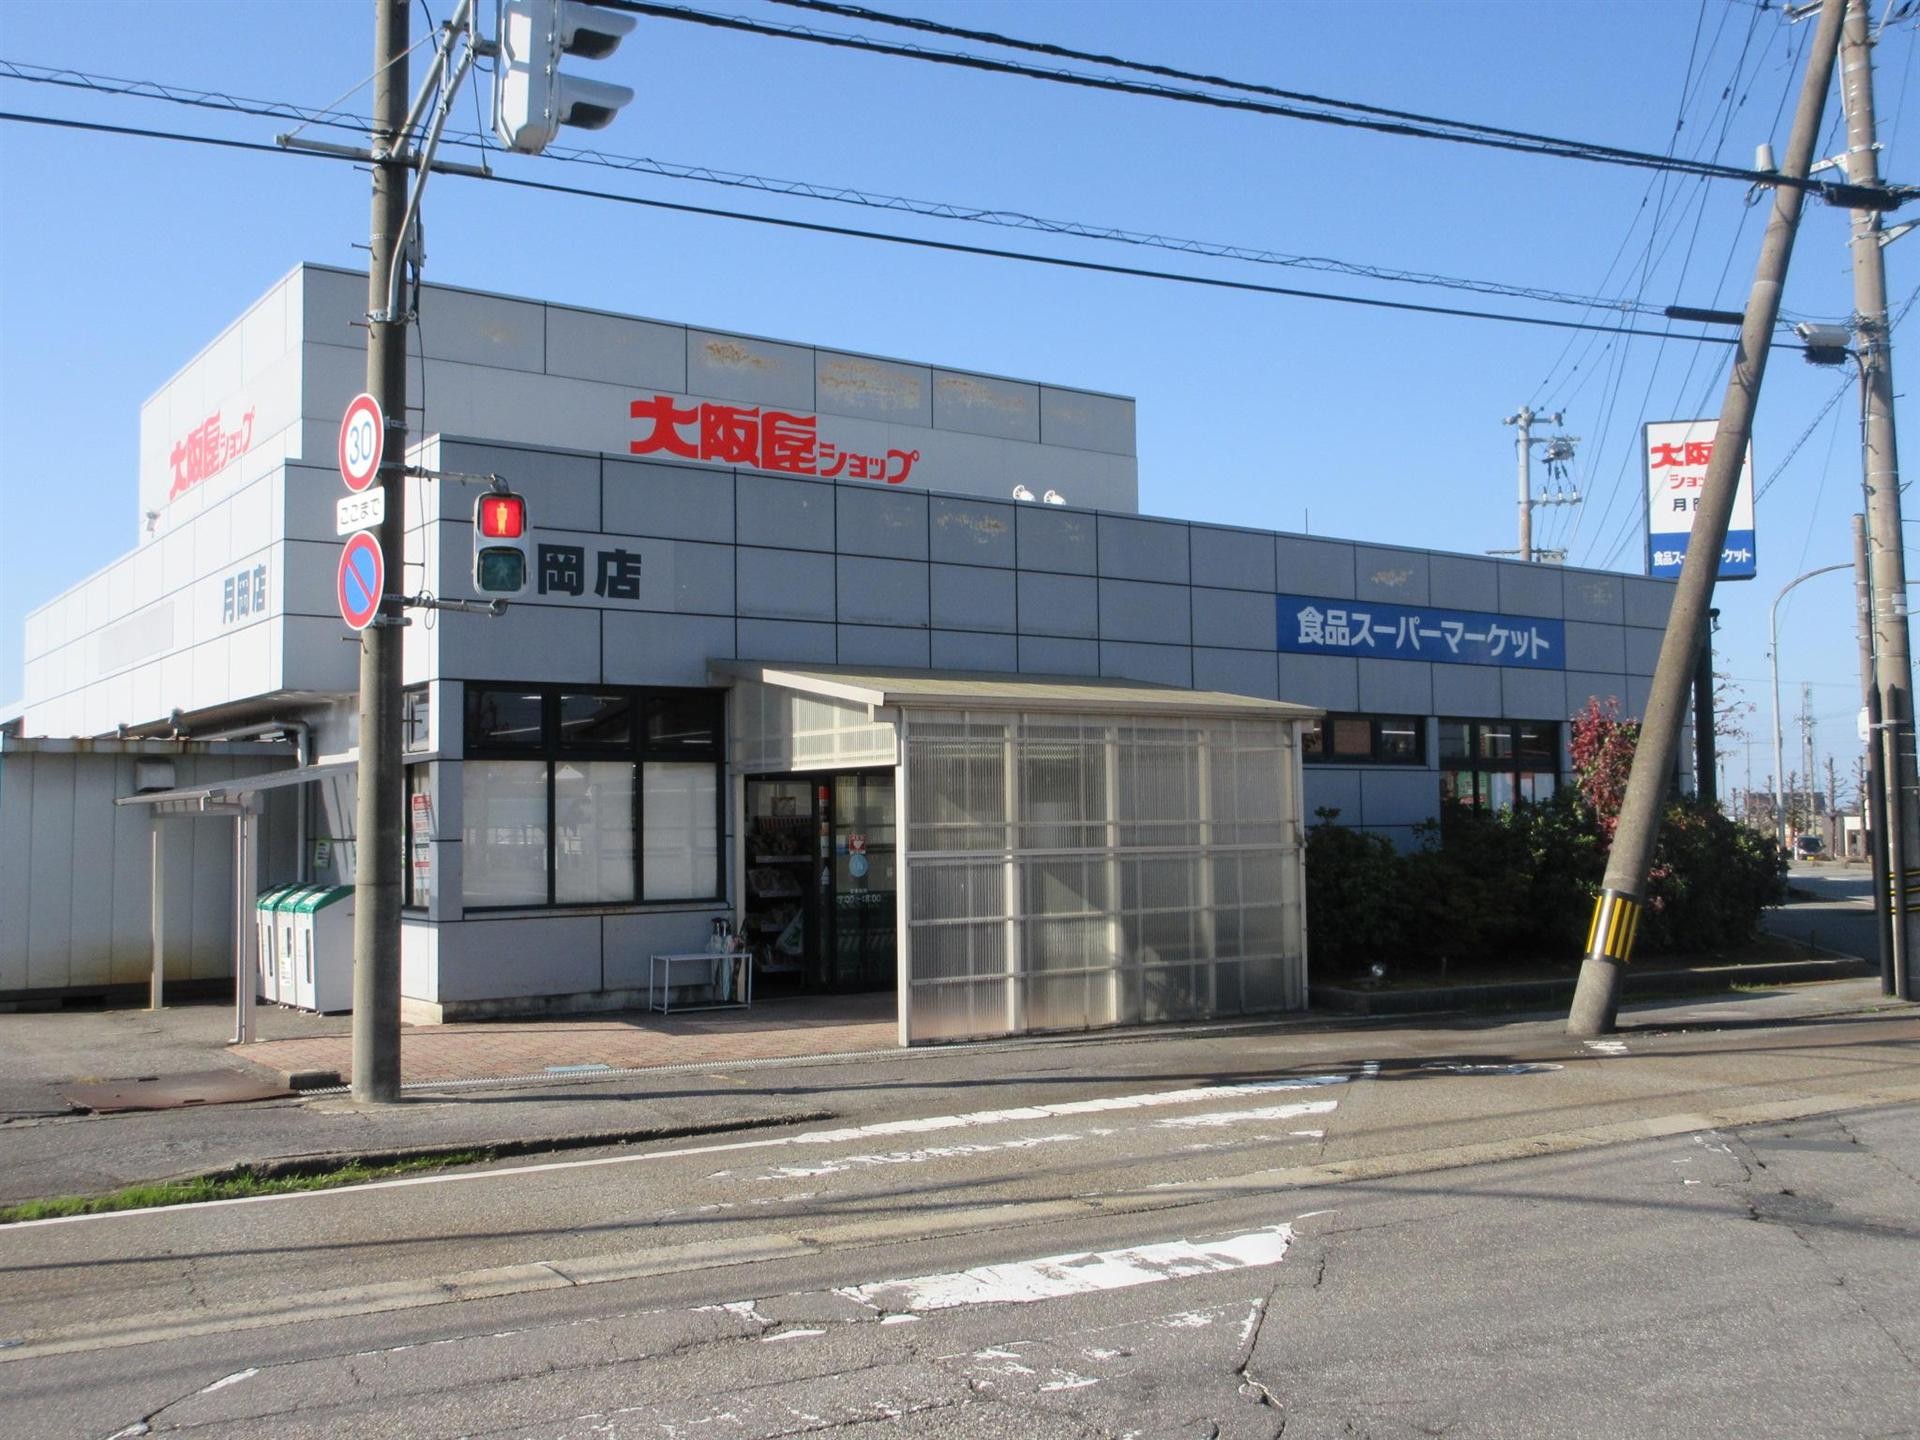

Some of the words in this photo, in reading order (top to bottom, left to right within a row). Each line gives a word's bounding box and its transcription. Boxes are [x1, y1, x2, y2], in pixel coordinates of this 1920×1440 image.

[169, 405, 256, 502] 大阪屋ショップ
[349, 420, 372, 465] 30
[630, 395, 920, 484] 大阪屋ショップ
[1650, 441, 1714, 469] 大阪
[1669, 474, 1704, 490] ショ
[340, 497, 381, 526] ここまで
[222, 563, 267, 625] 月岡店
[538, 543, 642, 600] 岡店
[1297, 606, 1550, 660] 食品スーパーマーケット
